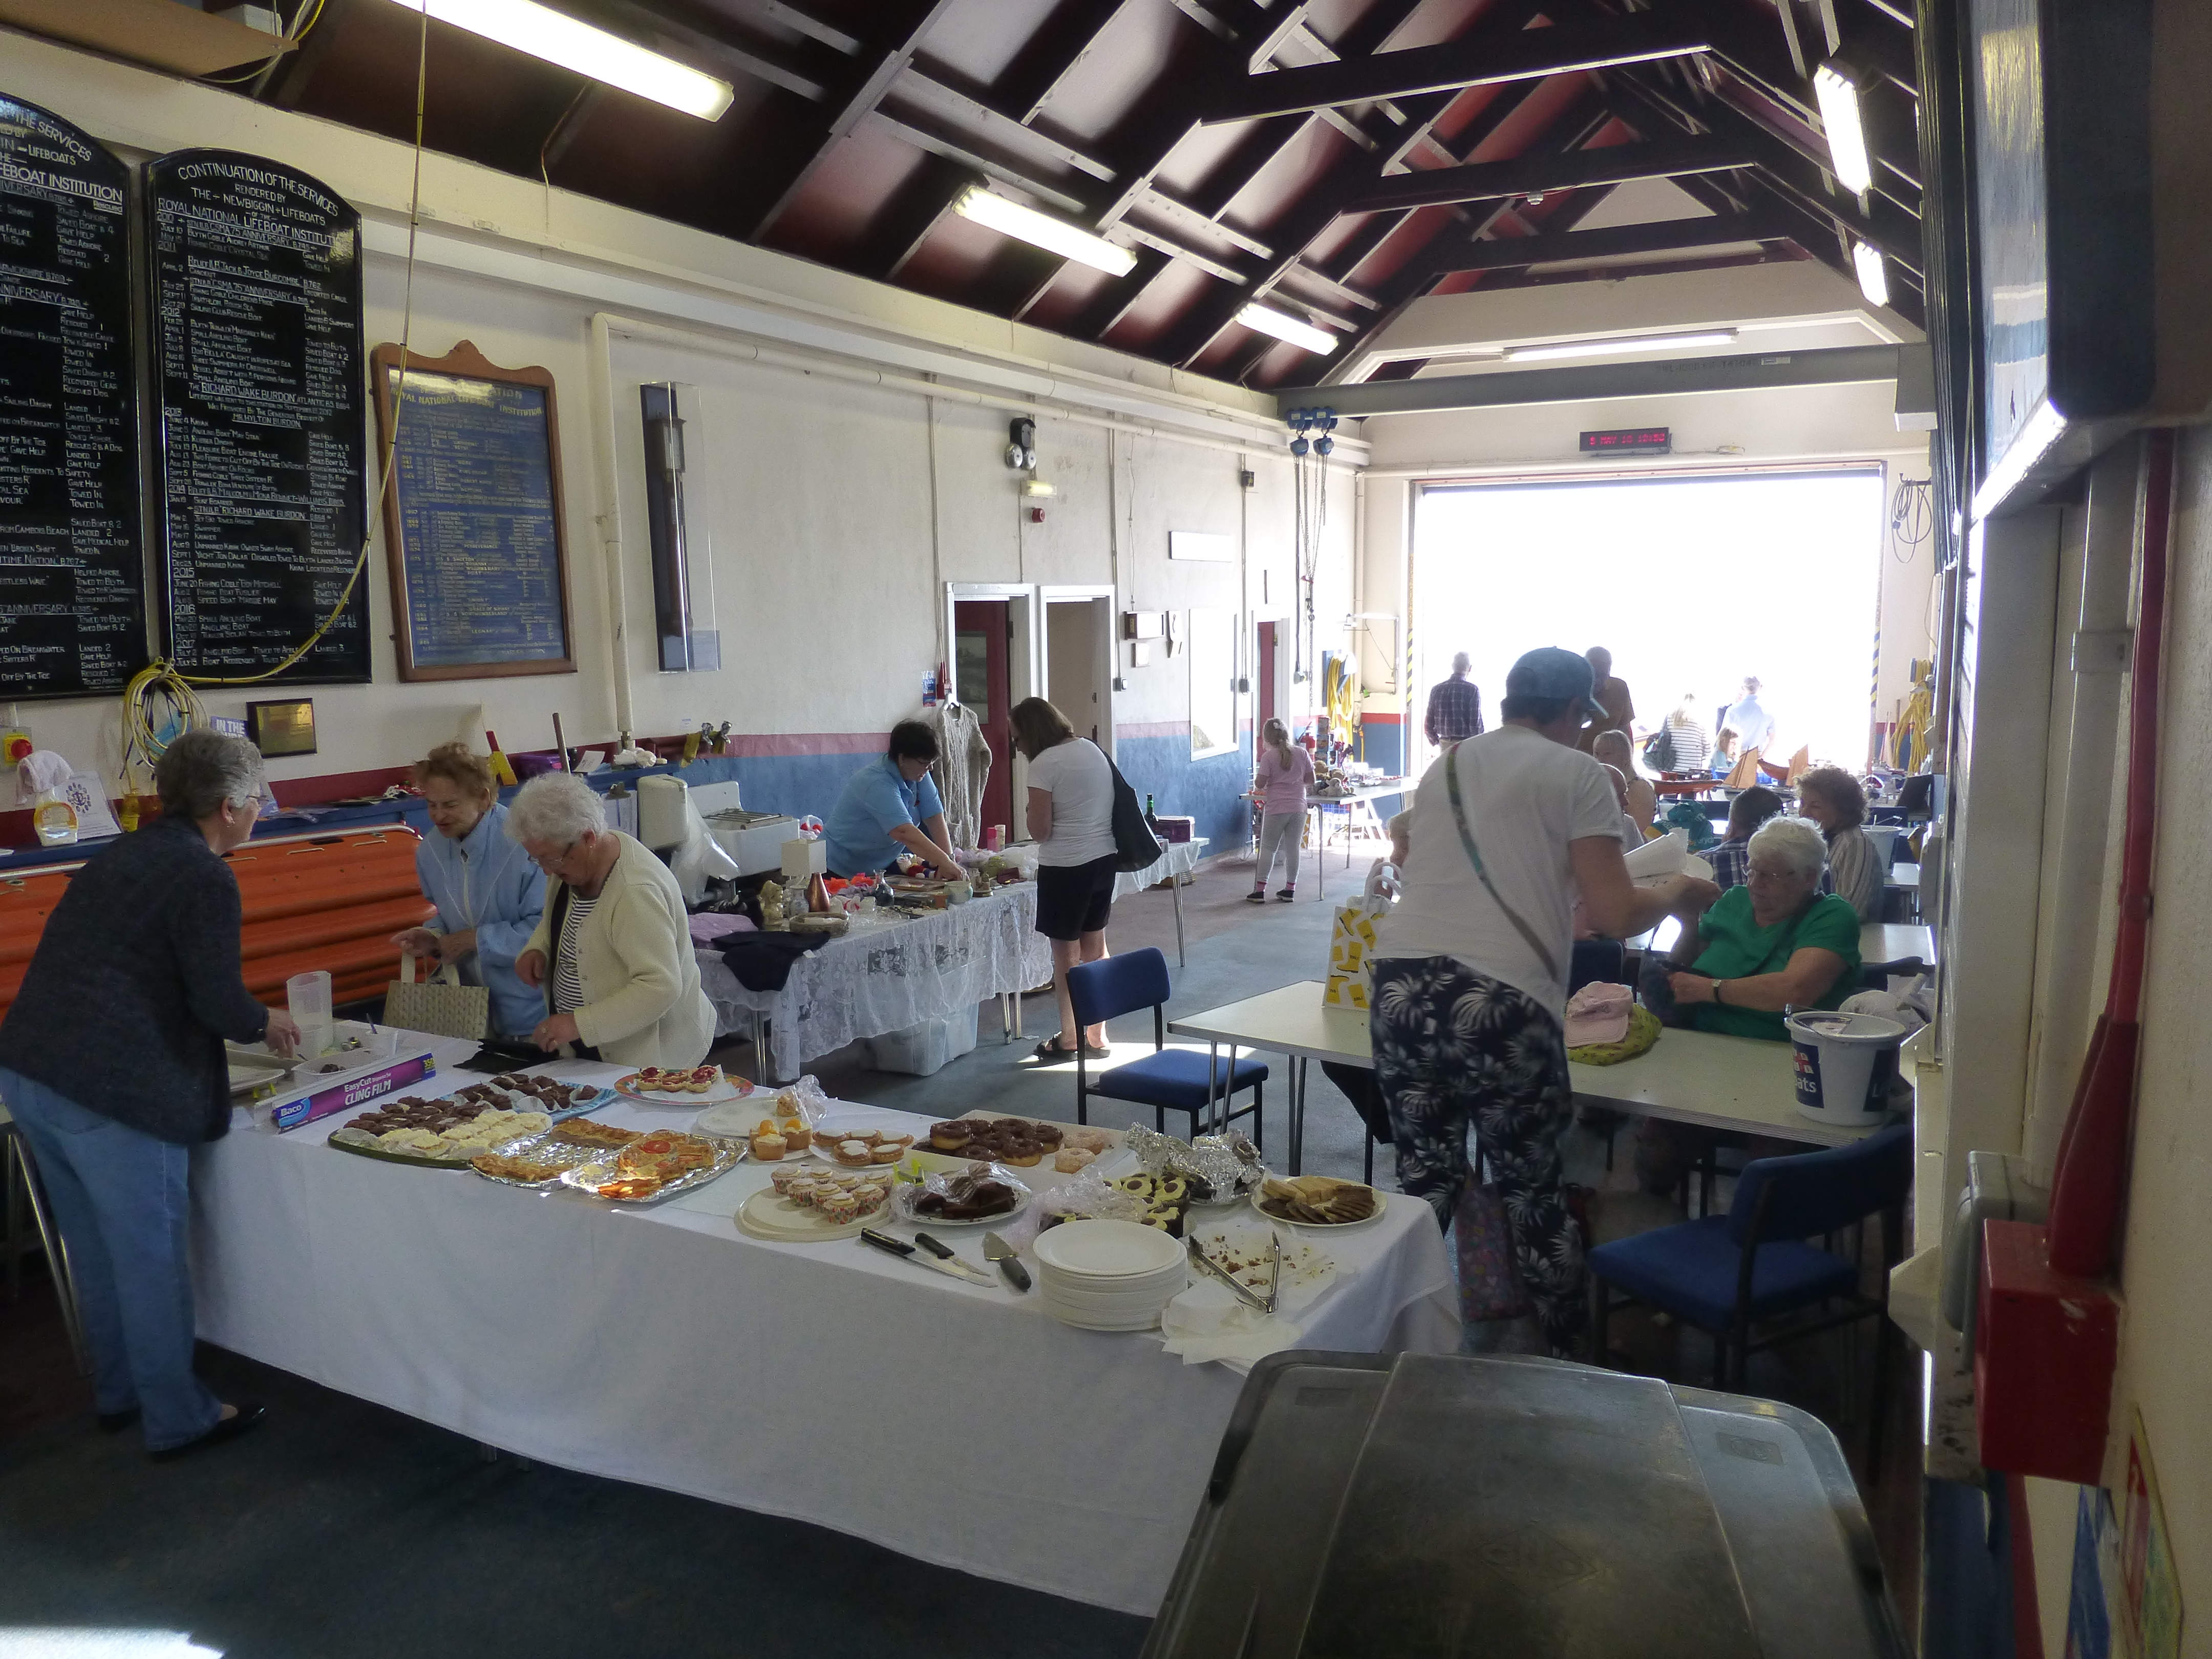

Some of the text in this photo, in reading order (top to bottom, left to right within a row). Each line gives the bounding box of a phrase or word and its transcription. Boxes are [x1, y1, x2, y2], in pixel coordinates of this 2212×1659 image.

[38, 121, 92, 161] SERVICES
[28, 144, 76, 165] LIFEBOATS
[49, 174, 122, 202] INSTITUTION
[178, 162, 338, 217] CONTINUATION OF THE SERVICES
[235, 184, 286, 203] RENDERED BY
[190, 187, 326, 226] THE NEWBIGGIN LIFEBOATS
[158, 198, 192, 216] ROYAL
[193, 204, 241, 226] NATIONAL
[244, 215, 290, 237] LIFEBOAT
[161, 307, 180, 316] 2012
[238, 386, 260, 398] WAKE
[174, 568, 195, 577] 2015
[174, 604, 196, 614] 2016
[216, 719, 245, 734] IN THE
[345, 1077, 372, 1094] EasyCut
[345, 1079, 391, 1105] CLING FILM
[281, 1104, 302, 1117] Baco
